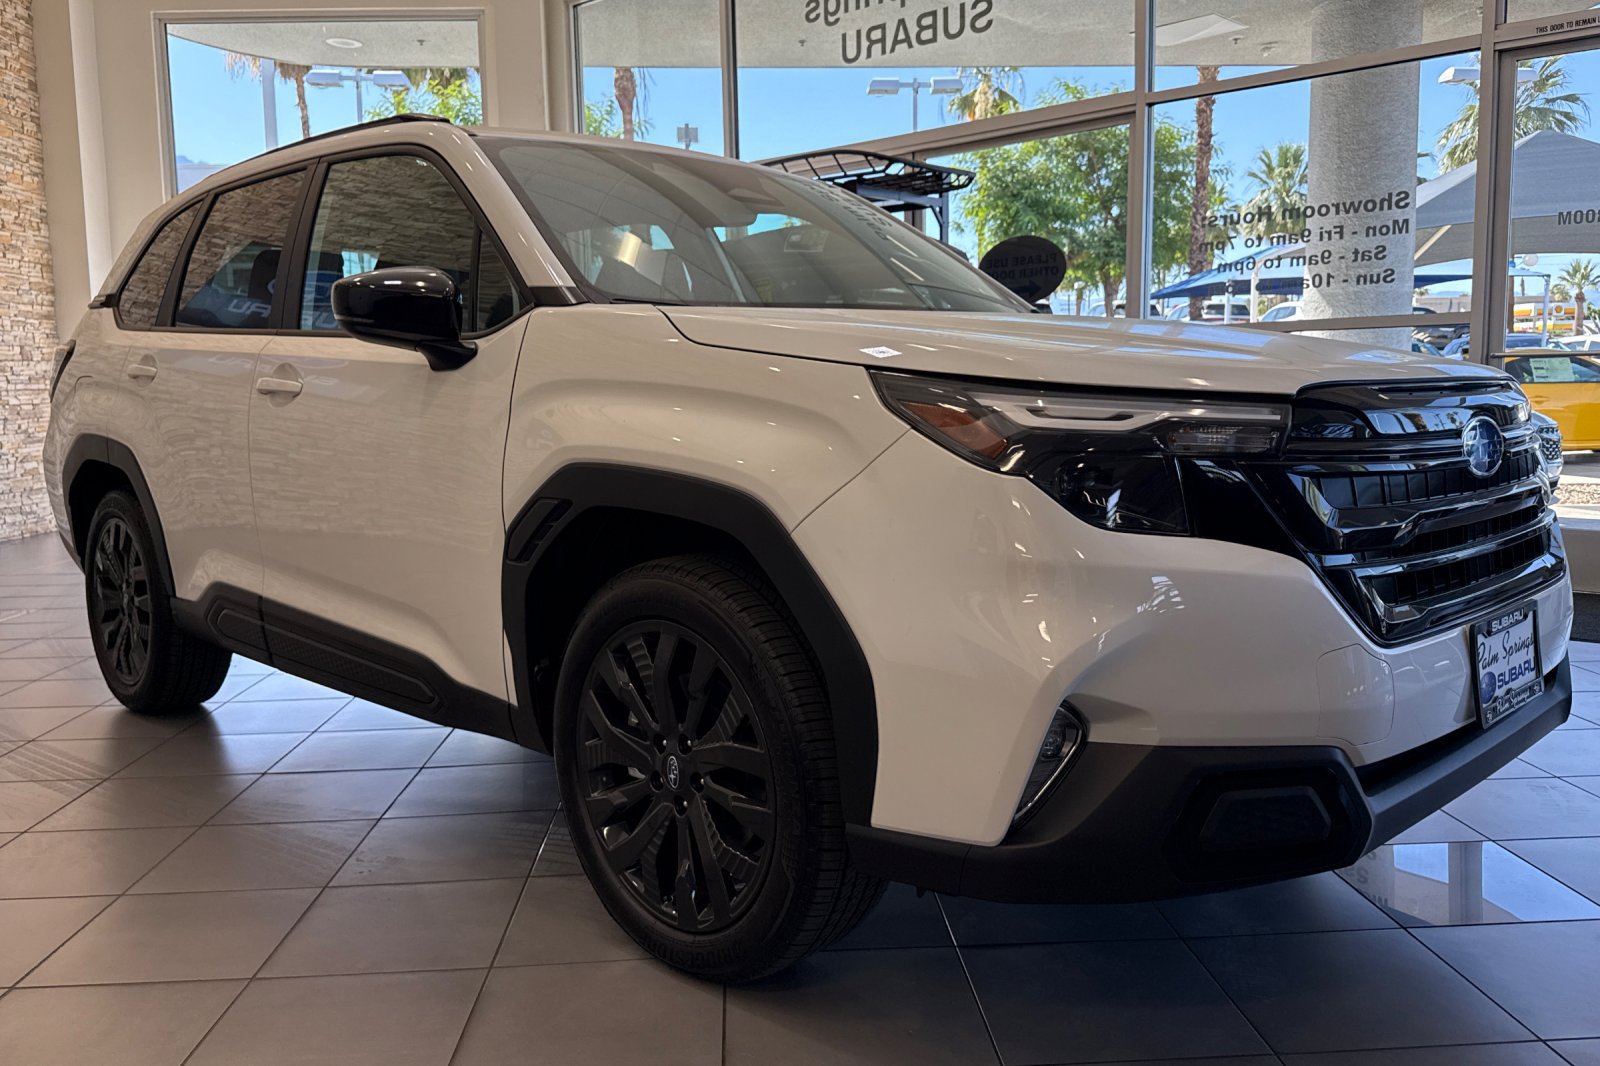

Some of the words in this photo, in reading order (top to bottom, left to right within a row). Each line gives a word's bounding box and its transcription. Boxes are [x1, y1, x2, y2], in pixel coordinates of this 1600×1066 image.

[1536, 26, 1548, 34] THIS
[1550, 23, 1564, 31] DOOR
[1575, 17, 1596, 26] REMAIN
[1491, 608, 1524, 632] SUBARU
[1478, 641, 1500, 671] Palm
[1502, 630, 1534, 666] Springs
[1497, 658, 1535, 690] SUBARU
